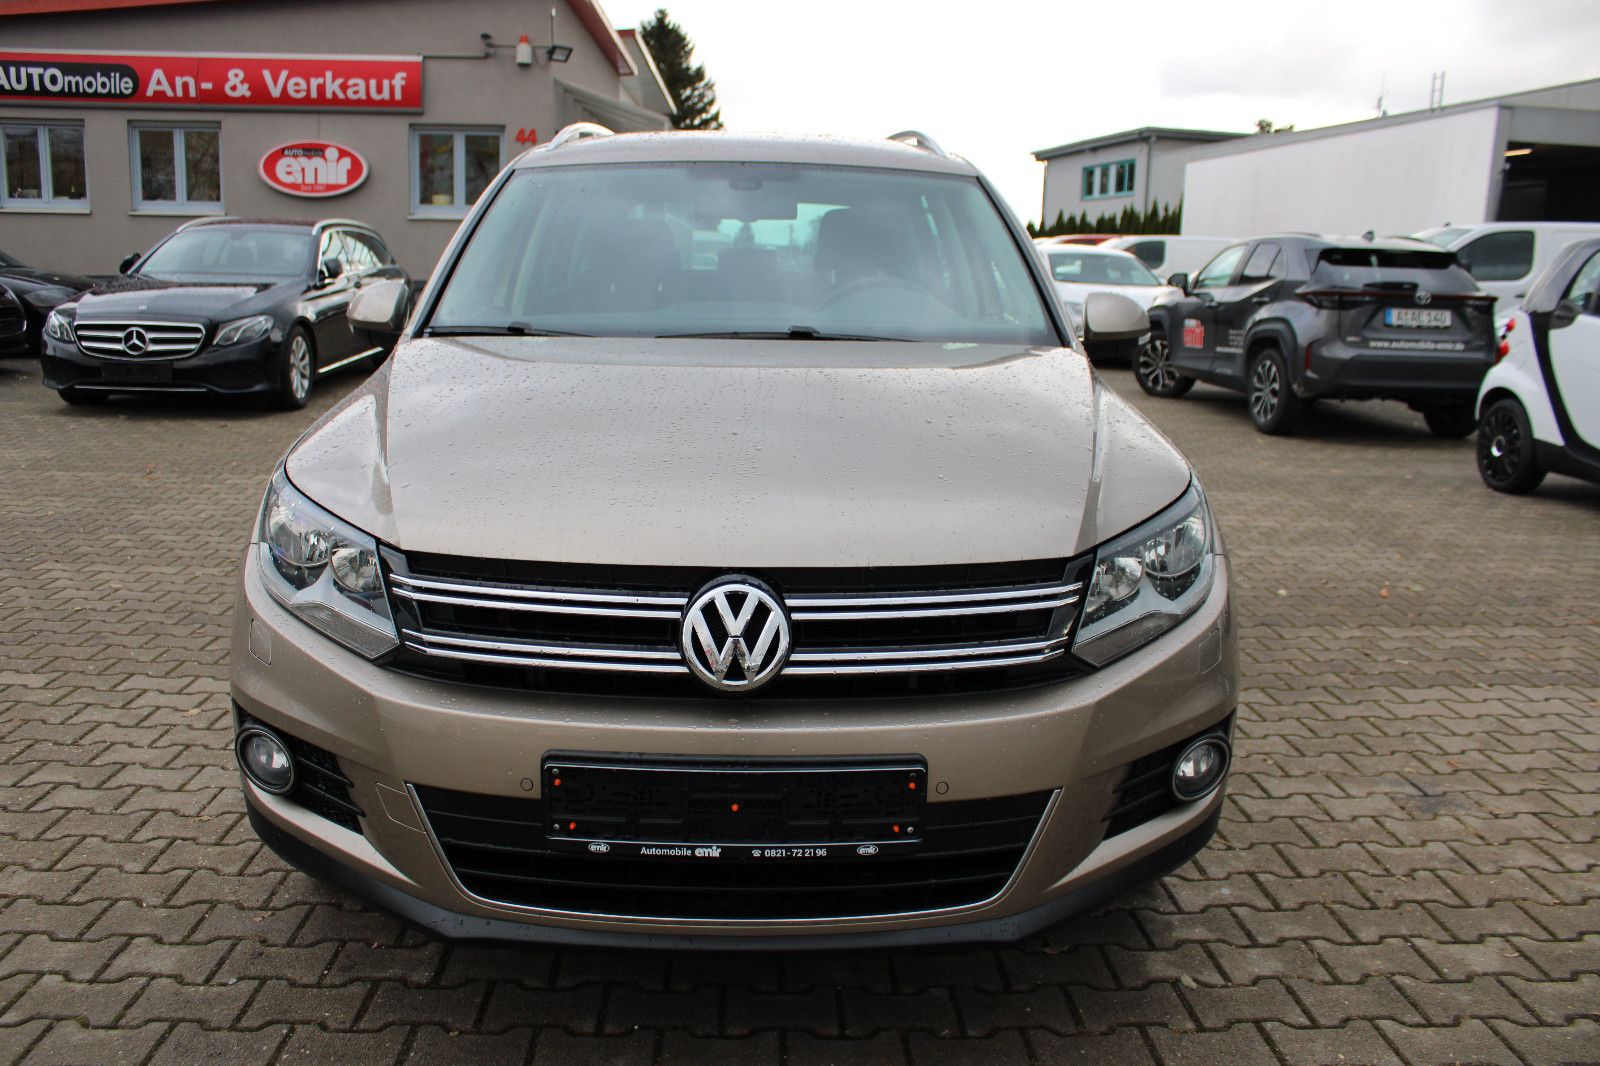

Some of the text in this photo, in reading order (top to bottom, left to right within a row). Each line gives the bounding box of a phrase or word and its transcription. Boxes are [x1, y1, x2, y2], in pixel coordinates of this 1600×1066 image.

[146, 68, 213, 98] An-
[224, 68, 252, 98] &
[262, 69, 407, 101] Verkauf
[516, 128, 537, 145] 44
[275, 146, 352, 185] emir
[640, 845, 721, 857] Automobile emir
